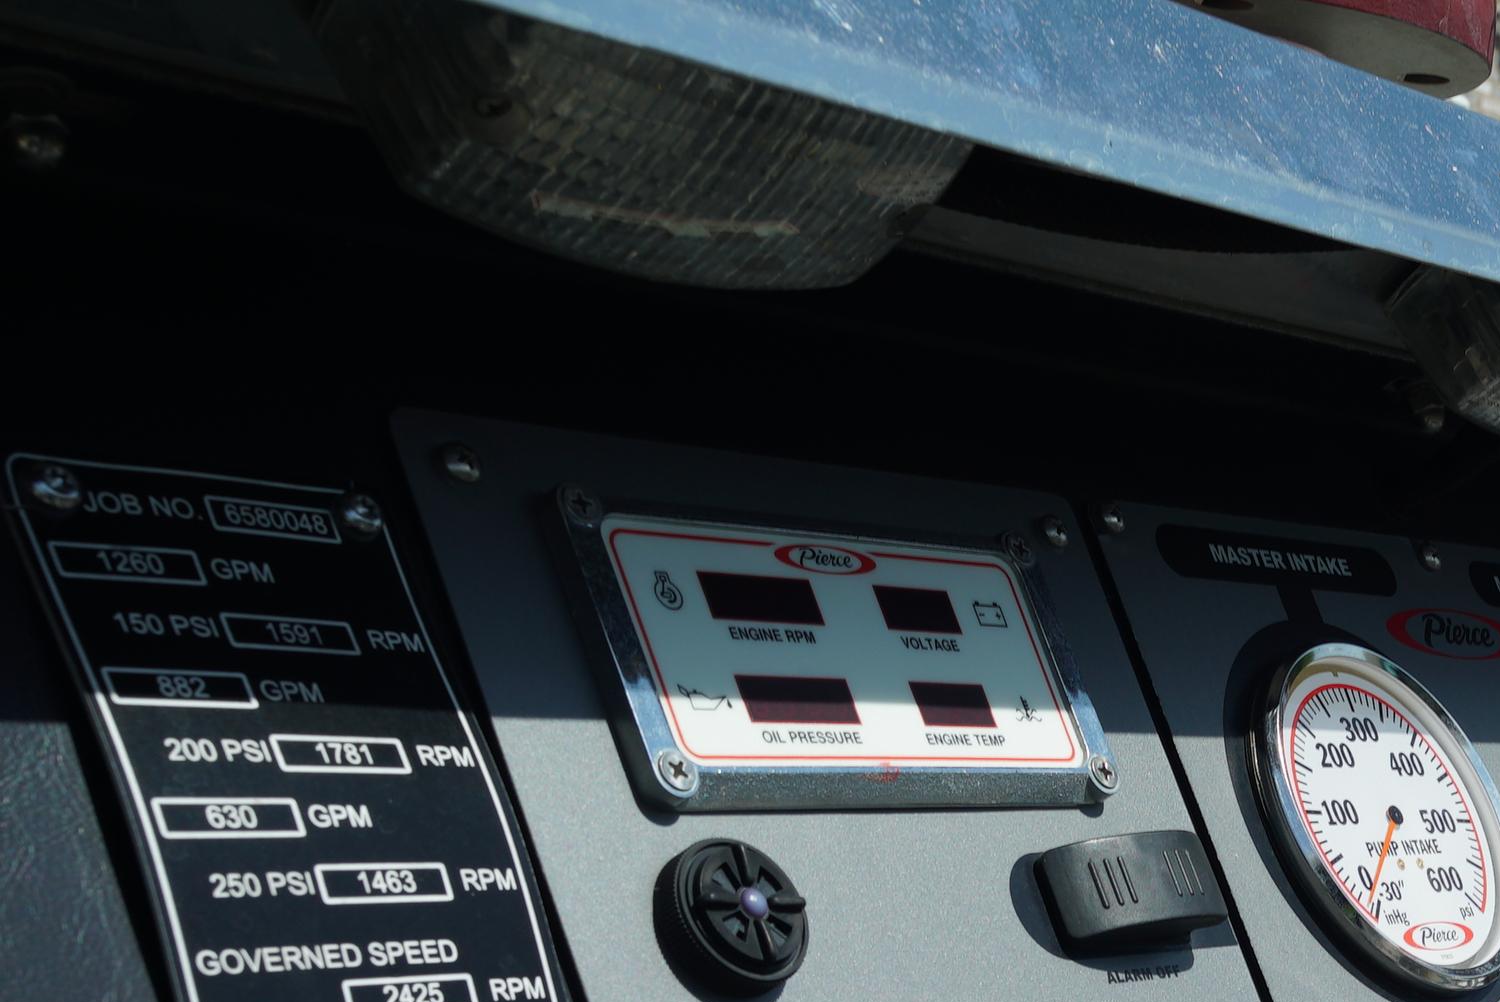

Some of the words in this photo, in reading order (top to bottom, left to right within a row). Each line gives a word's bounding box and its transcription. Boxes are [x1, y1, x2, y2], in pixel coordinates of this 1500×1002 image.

[83, 491, 142, 516] JOB
[148, 496, 203, 521] NO.
[224, 505, 328, 536] 6580048
[97, 550, 164, 576] 1260
[210, 558, 275, 584] GPM
[798, 547, 854, 570] Pierce
[1208, 543, 1285, 570] MASTER
[1286, 551, 1353, 577] INTAKE
[113, 612, 164, 637] 150
[171, 615, 219, 639] PSI
[265, 621, 324, 647] 1591
[367, 630, 425, 653] RPM
[728, 626, 787, 643] ENGINE
[789, 629, 817, 645] RPM
[1420, 614, 1495, 648] Pierce
[901, 636, 960, 652] VOLTAGE
[157, 675, 208, 700] 882
[260, 680, 325, 704] GPM
[761, 730, 783, 745] OIL
[786, 730, 864, 745] PRESSURE
[925, 733, 972, 747] ENGINE
[973, 733, 1006, 748] TEMP
[1340, 716, 1379, 742] 300
[164, 737, 218, 763] 200
[221, 740, 272, 763] PSI
[315, 741, 374, 767] 1781
[419, 745, 475, 768] RPM
[1316, 743, 1355, 768] 200
[1390, 752, 1424, 776] 400
[206, 803, 258, 830] 630
[307, 804, 372, 830] GPM
[1321, 799, 1359, 825] 100
[1419, 810, 1456, 834] 500
[1402, 839, 1442, 856] INTAKE
[209, 872, 262, 898] 250
[267, 871, 315, 897] PSI
[357, 870, 418, 895] 1463
[460, 868, 517, 891] RPM
[1358, 865, 1373, 891] 0
[1426, 866, 1463, 892] 600
[1383, 909, 1410, 926] inHg
[1460, 902, 1475, 920] psi
[1420, 926, 1458, 947] Pierce
[195, 943, 363, 976] GOVERNED
[368, 939, 458, 966] SPEED
[1106, 966, 1154, 985] ALARM
[1155, 964, 1181, 982] OFF
[489, 977, 546, 1002] RPM
